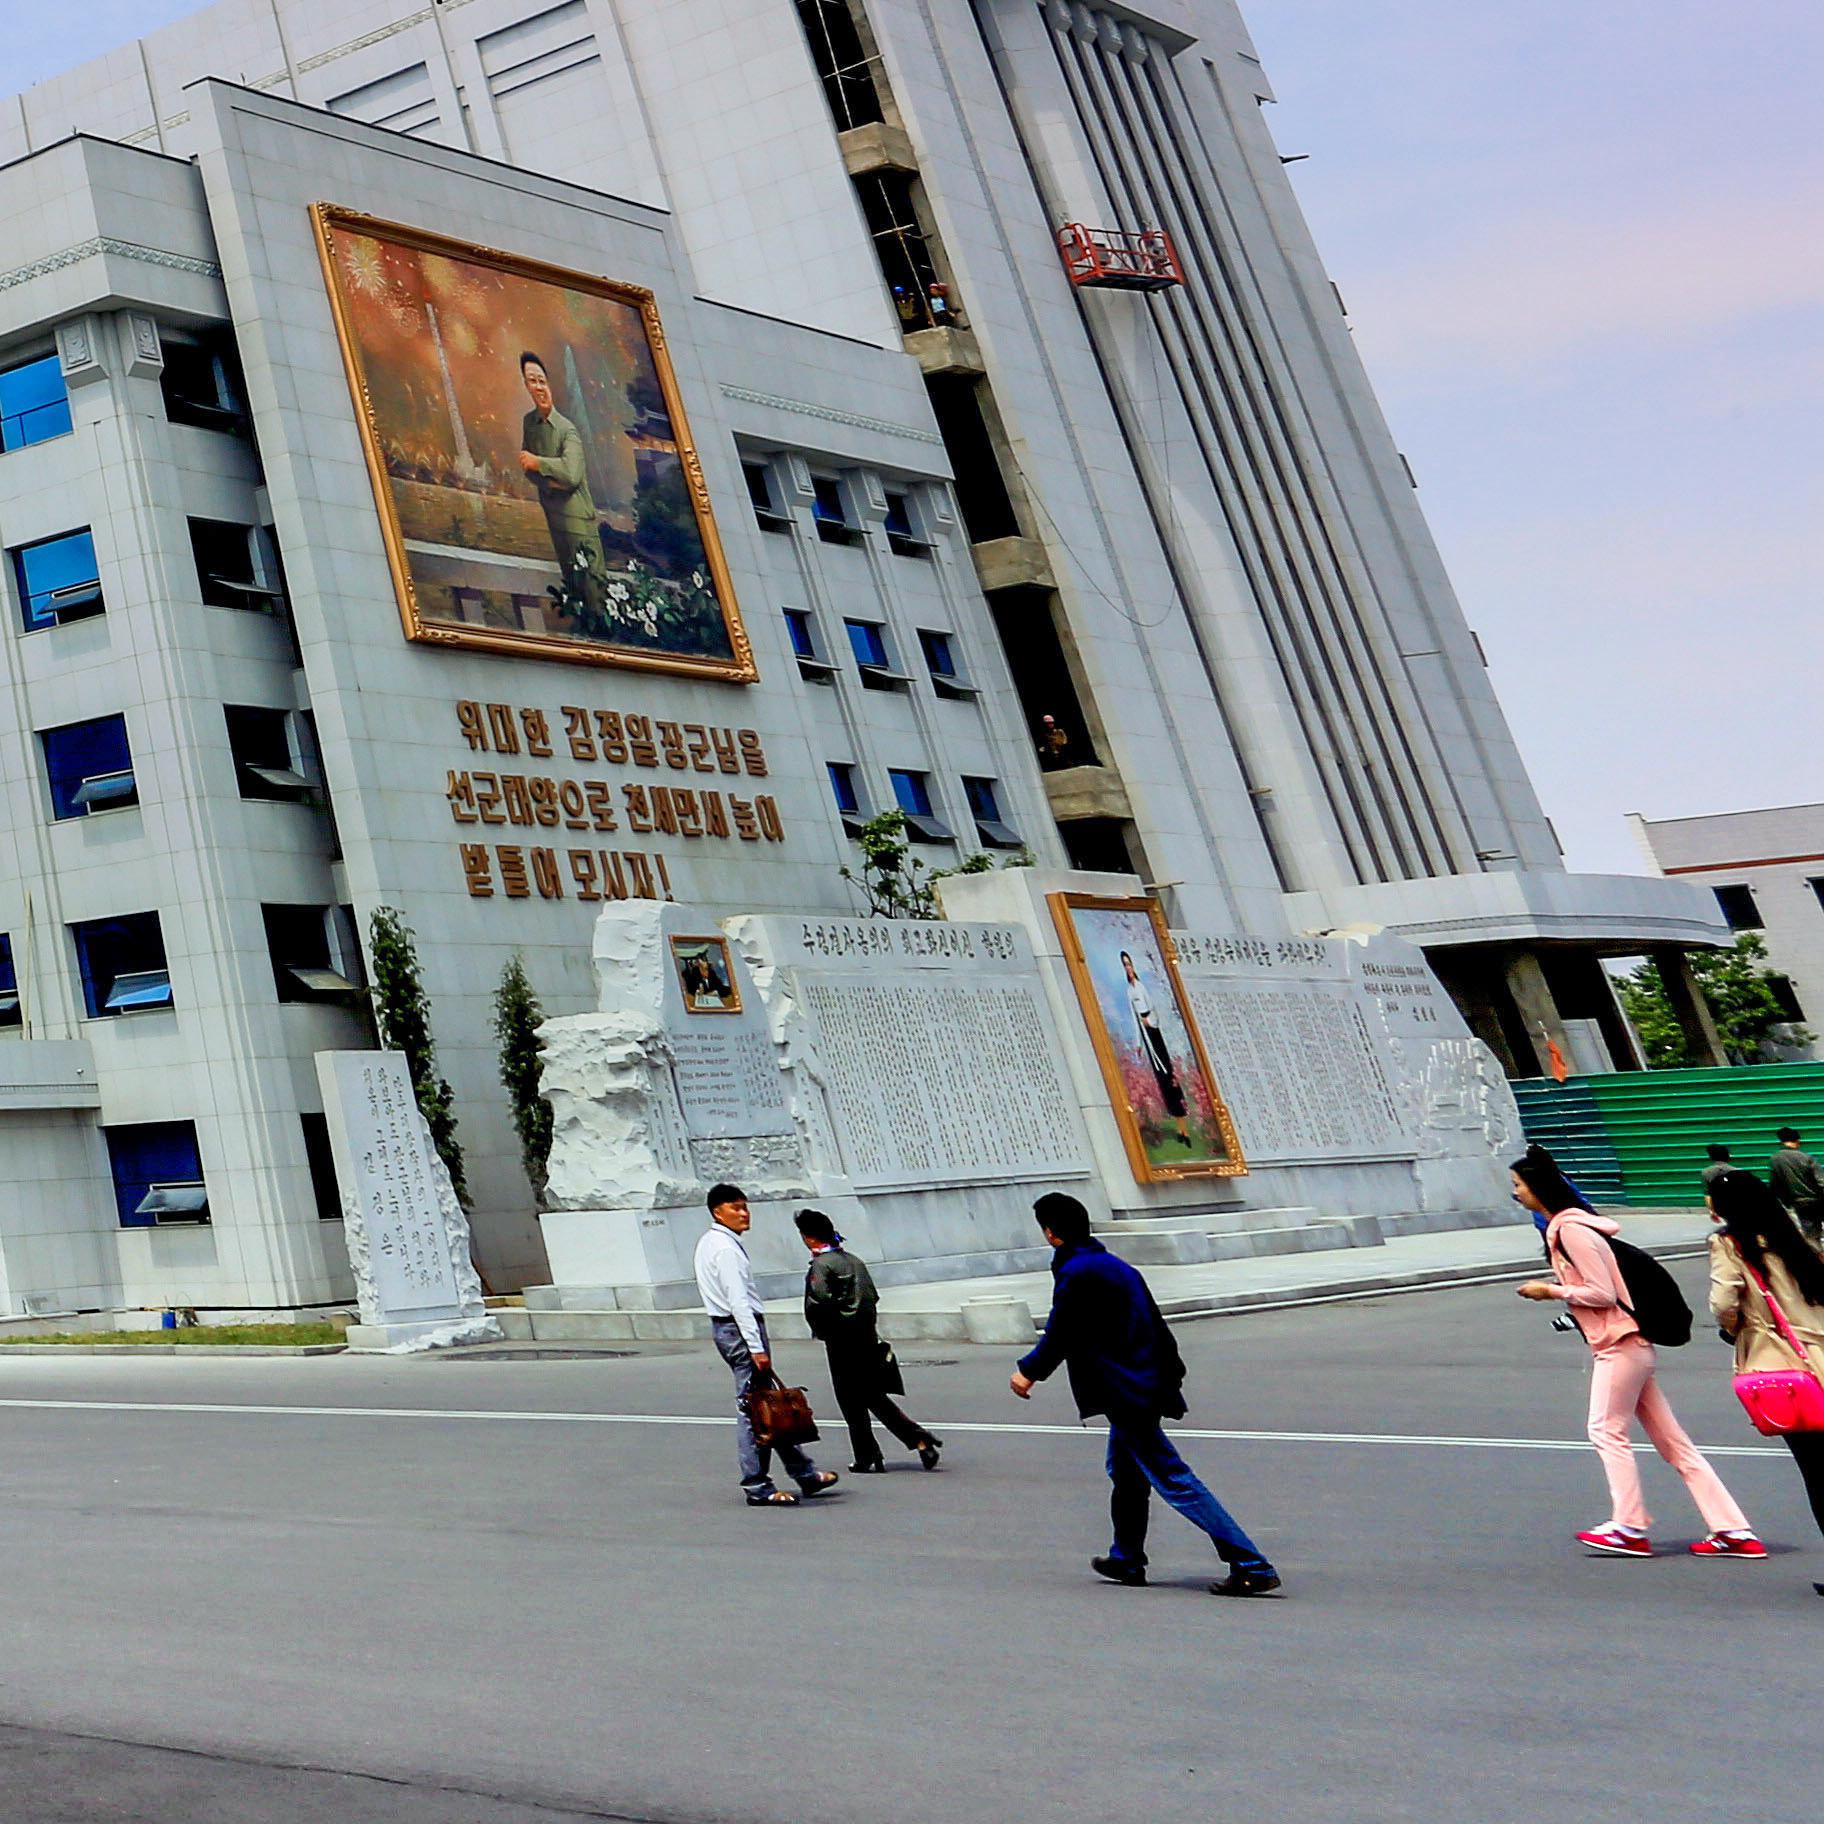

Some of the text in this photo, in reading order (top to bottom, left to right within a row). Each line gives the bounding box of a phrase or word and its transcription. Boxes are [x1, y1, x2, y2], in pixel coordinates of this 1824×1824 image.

[457, 700, 769, 776] 위대한 김정일장군님을
[446, 770, 786, 842] 선군태양으로 천세만세 높이
[459, 843, 564, 898] 받들어
